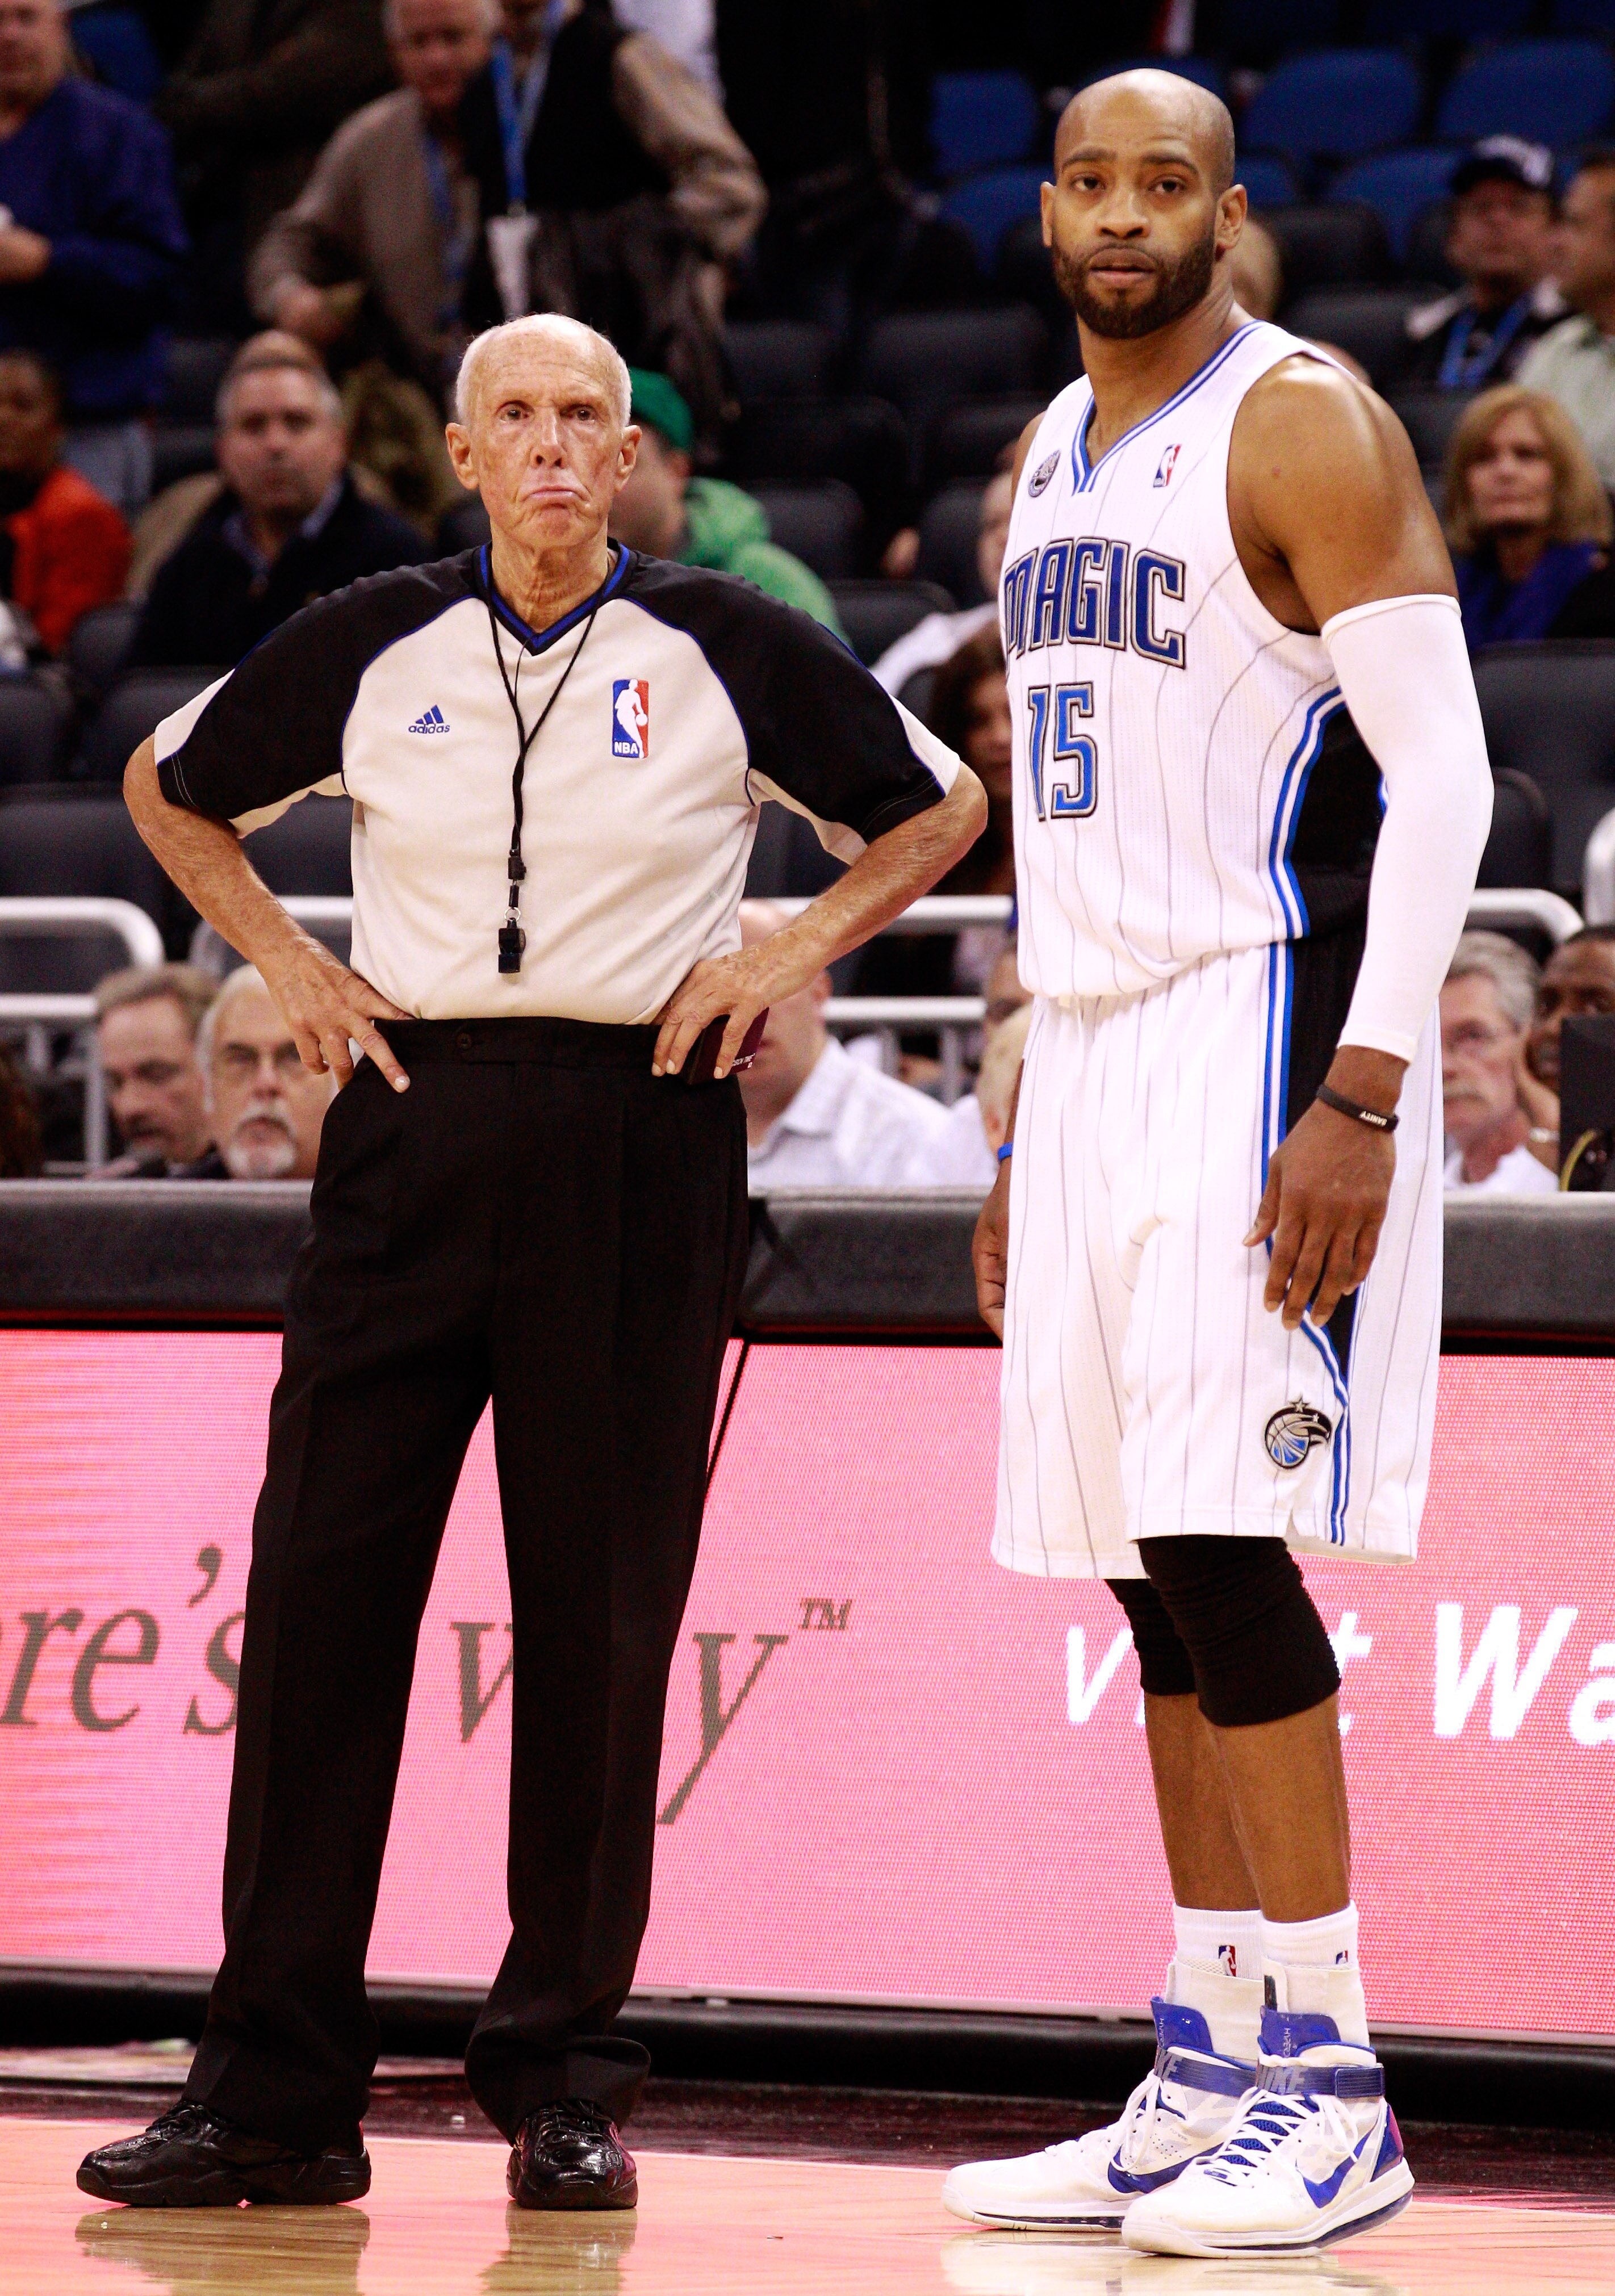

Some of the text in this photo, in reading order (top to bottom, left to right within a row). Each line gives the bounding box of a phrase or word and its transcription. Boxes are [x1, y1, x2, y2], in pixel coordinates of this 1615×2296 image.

[1004, 536, 1186, 671] MAGIC
[408, 723, 450, 734] adidas
[614, 741, 638, 754] NBA
[1028, 681, 1097, 821] 15
[0, 1542, 246, 1736] re's
